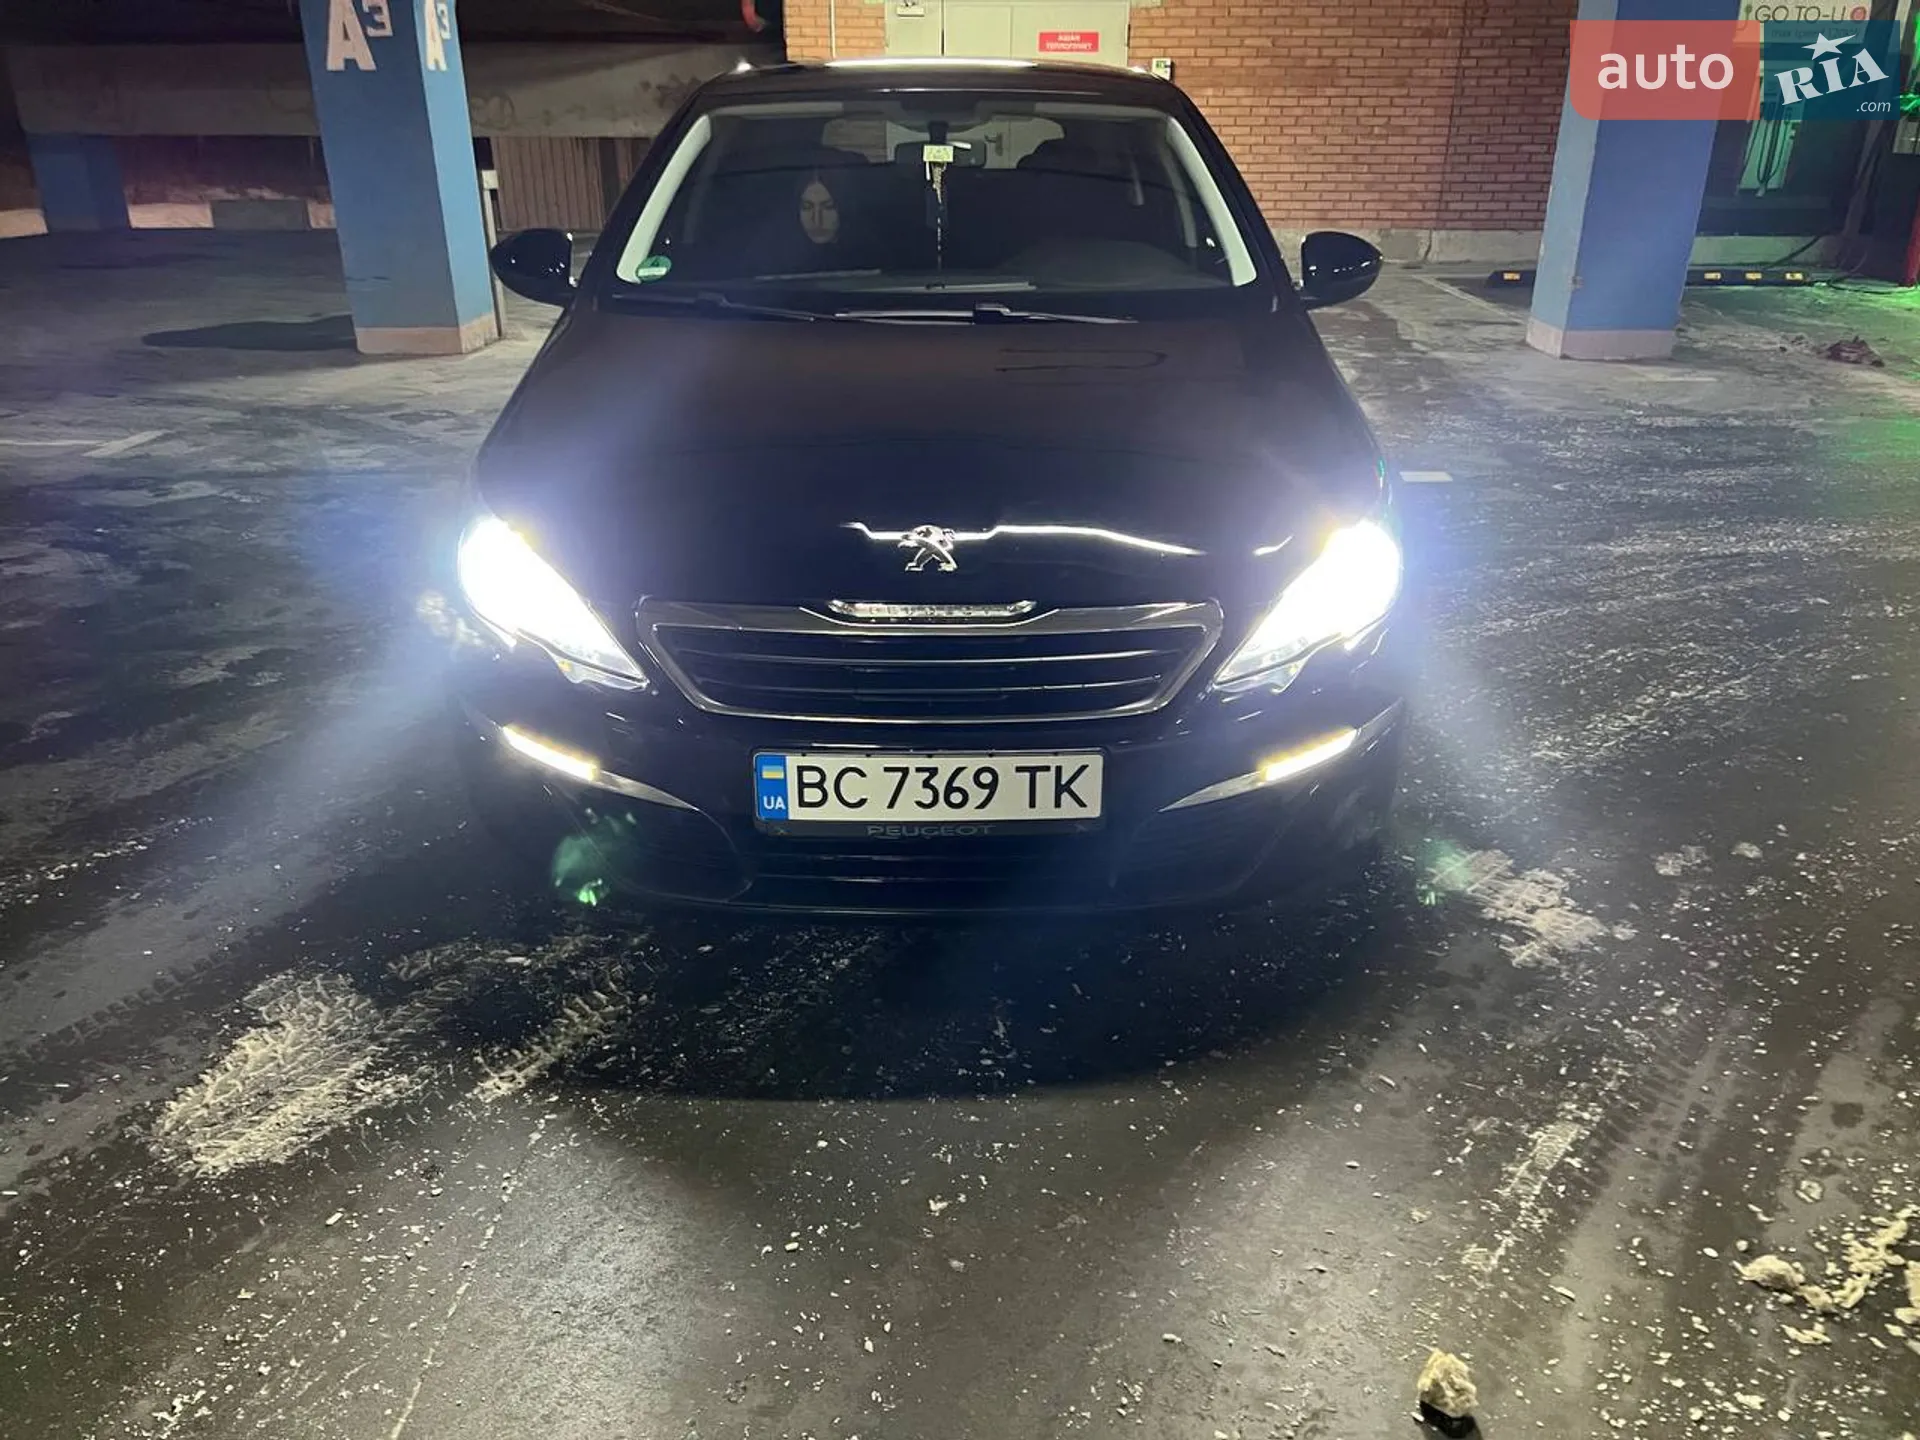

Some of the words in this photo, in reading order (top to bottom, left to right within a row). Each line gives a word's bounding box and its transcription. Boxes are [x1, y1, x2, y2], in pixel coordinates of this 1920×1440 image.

[796, 765, 868, 809] BC
[883, 765, 999, 810] 7369
[1015, 764, 1089, 809] TK
[763, 797, 786, 810] UA
[866, 824, 997, 837] PEUGEOT
